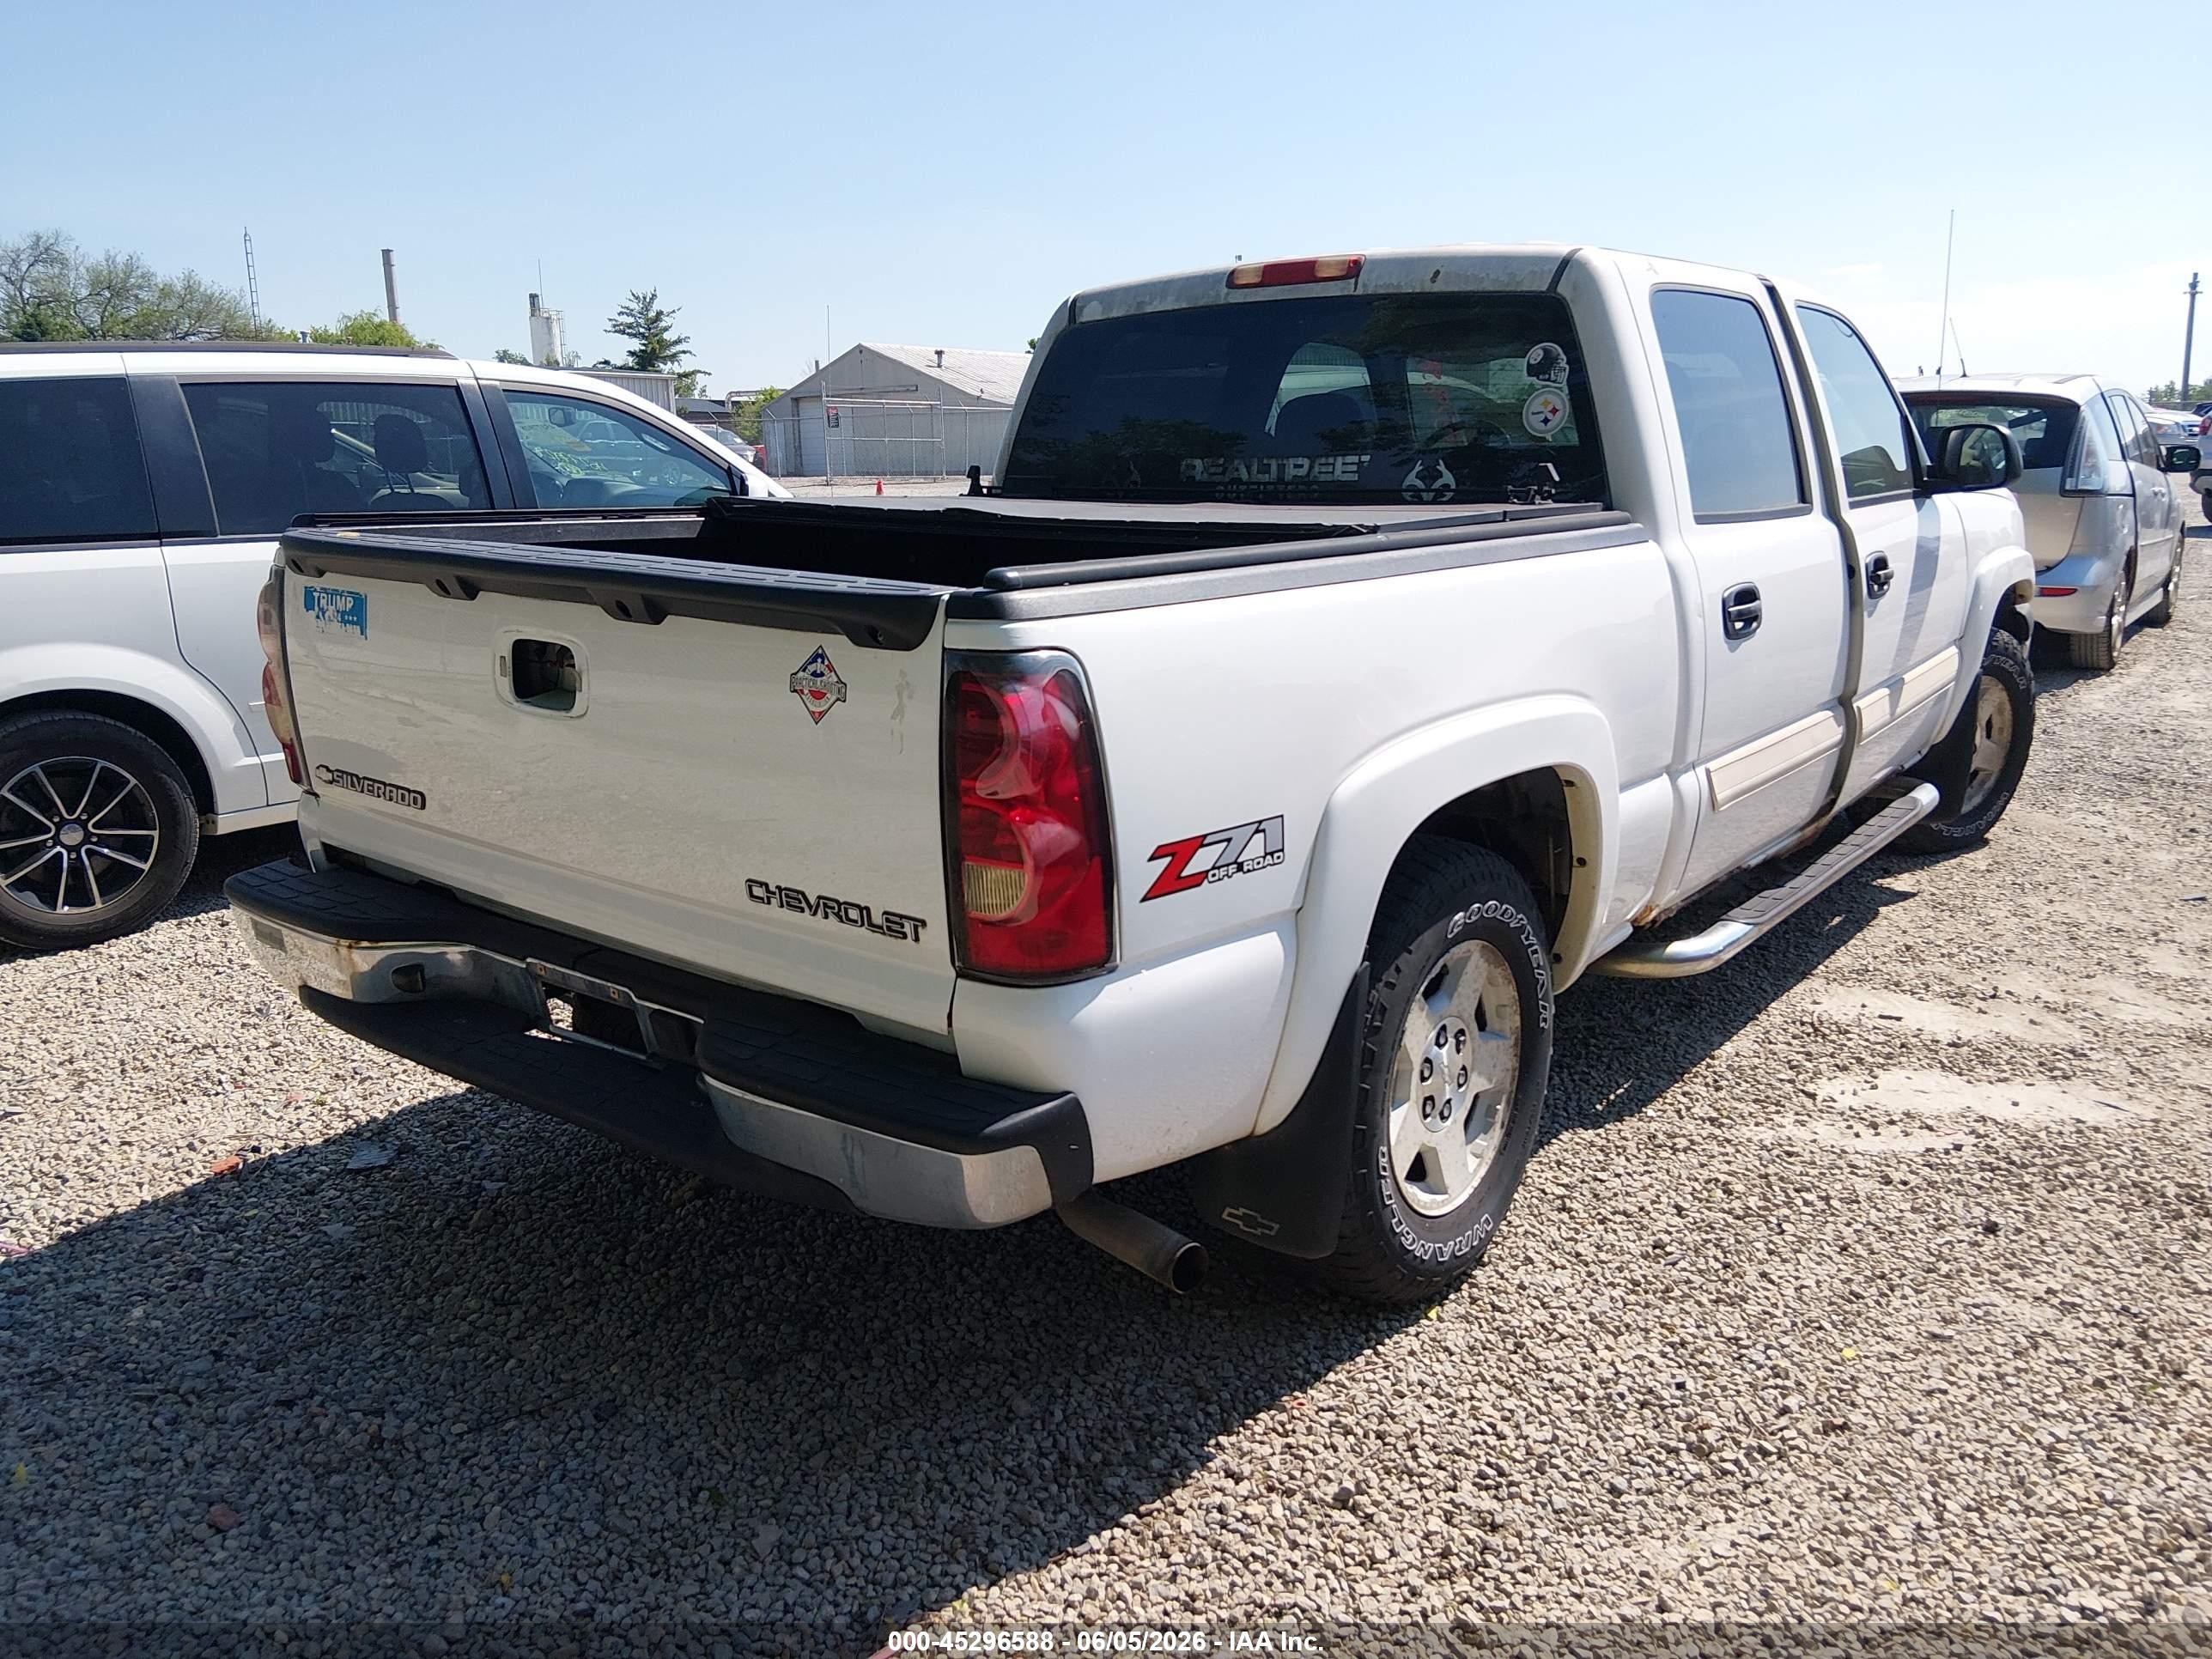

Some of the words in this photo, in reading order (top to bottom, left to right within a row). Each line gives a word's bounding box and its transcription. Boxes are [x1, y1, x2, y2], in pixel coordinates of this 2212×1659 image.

[313, 592, 354, 611] TRUMP
[332, 769, 426, 810] SILVERADO
[1139, 814, 1284, 902] Z71
[1206, 864, 1237, 884] OFF
[1243, 852, 1285, 875] ROAD
[745, 878, 927, 943] CHEVROLET
[1447, 901, 1549, 1029] GOODYEAR
[1378, 1146, 1493, 1261] WRANGLER
